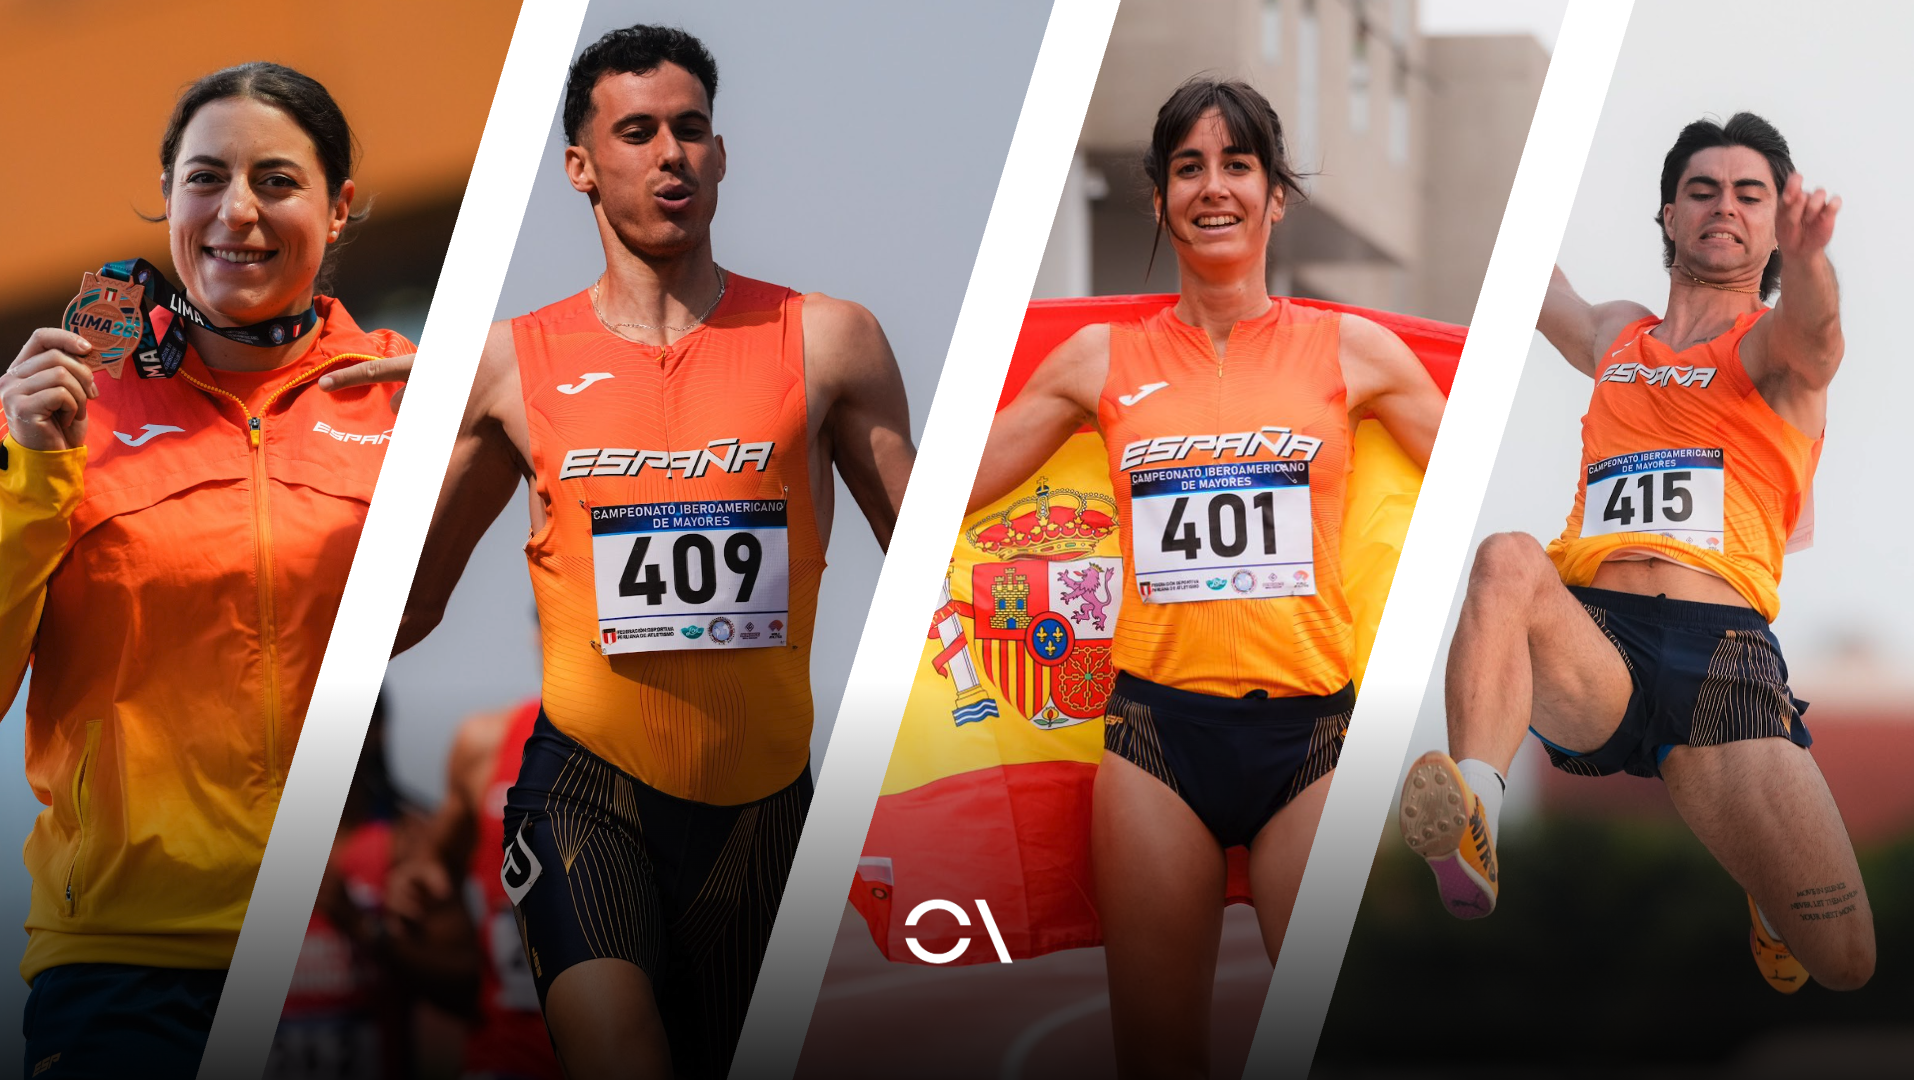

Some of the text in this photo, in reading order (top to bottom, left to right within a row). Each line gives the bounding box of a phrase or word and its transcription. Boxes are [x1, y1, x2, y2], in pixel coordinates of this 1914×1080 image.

[169, 293, 205, 327] LIMA
[1596, 363, 1717, 388] ESPAÑA
[558, 438, 776, 481] ESPAÑA
[1120, 425, 1323, 471] ESPAÑA
[1131, 462, 1305, 484] CAMPEONATO IBEROAMERICANO
[1588, 449, 1721, 475] CAMPEONATO IBEROAMERICANO
[1622, 459, 1676, 473] DE MAYORES
[1181, 477, 1252, 490] DE MAYORES
[593, 502, 784, 520] CAMPEONATO IBEROAMERICANO
[1603, 471, 1693, 526] 415
[653, 516, 730, 529] DE MAYORES
[1161, 491, 1277, 560] 401
[618, 531, 763, 606] 409
[32, 1052, 62, 1078] ESP
